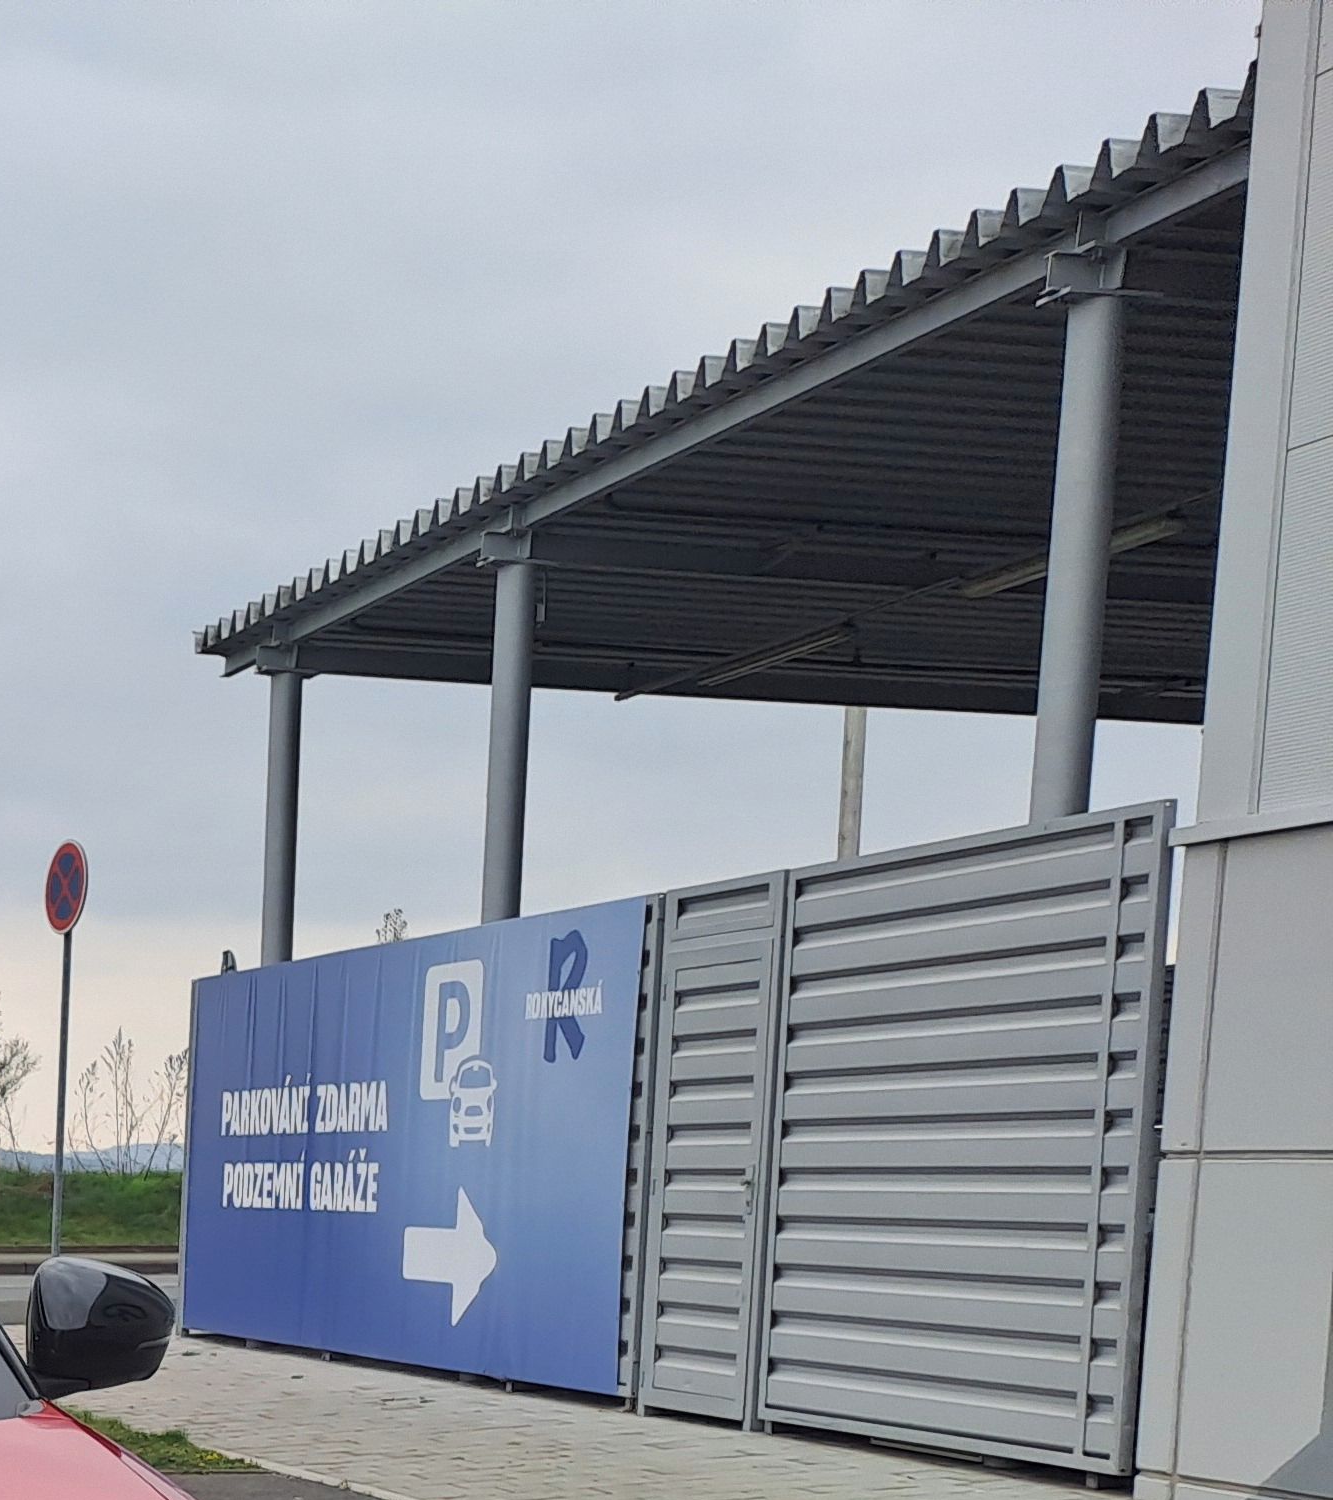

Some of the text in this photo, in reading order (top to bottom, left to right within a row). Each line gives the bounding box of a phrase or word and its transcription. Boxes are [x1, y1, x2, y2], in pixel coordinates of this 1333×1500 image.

[434, 980, 471, 1082] P
[525, 979, 603, 1020] ROKYCANSKÁ
[221, 1073, 388, 1136] PARKOVÁNÍ ZDARMA
[222, 1148, 379, 1213] PODZEMNÍ GARÁŽE
